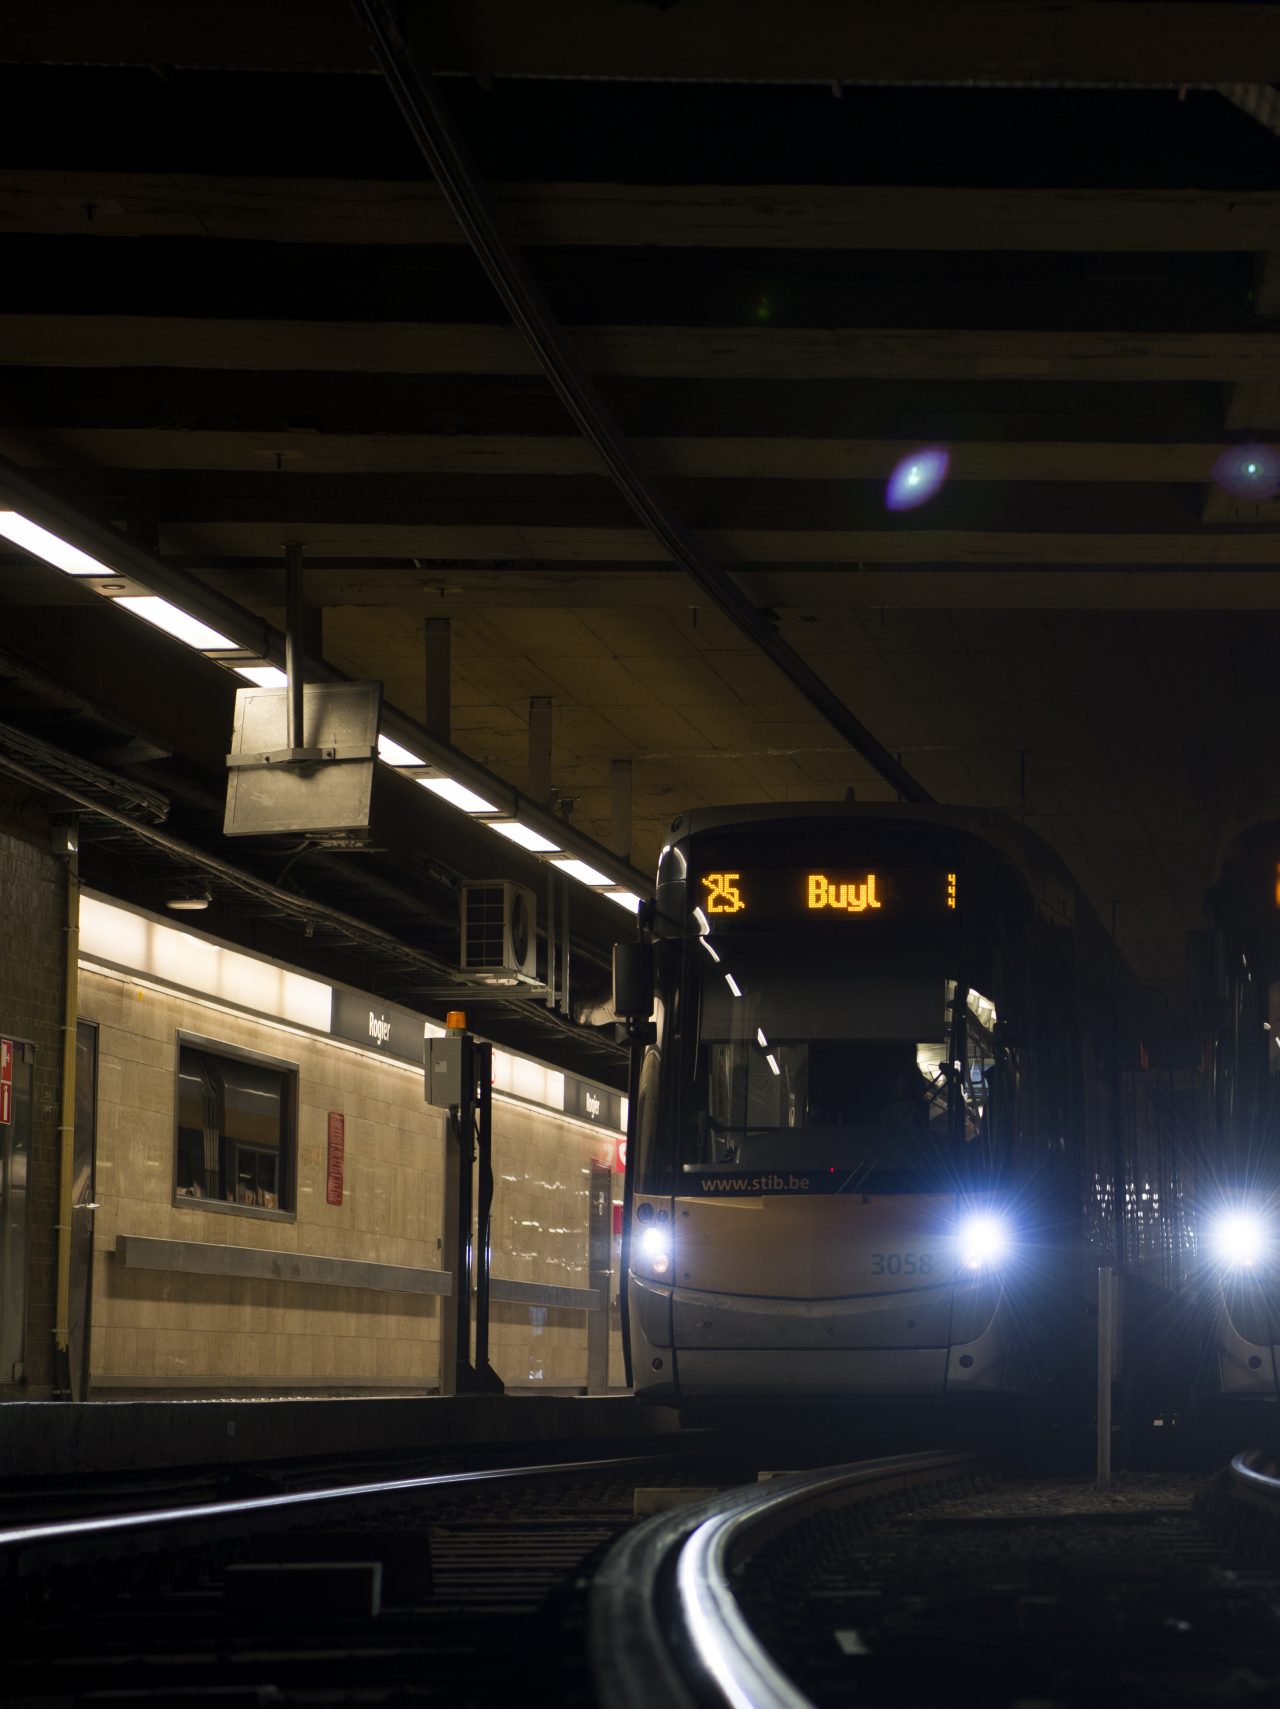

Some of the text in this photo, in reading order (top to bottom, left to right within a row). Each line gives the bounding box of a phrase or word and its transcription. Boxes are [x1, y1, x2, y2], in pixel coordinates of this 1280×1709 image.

[704, 873, 881, 913] 25 Buyl
[368, 1011, 391, 1046] Rogier
[701, 1174, 810, 1191] www.stib.be
[871, 1253, 934, 1276] 3058
